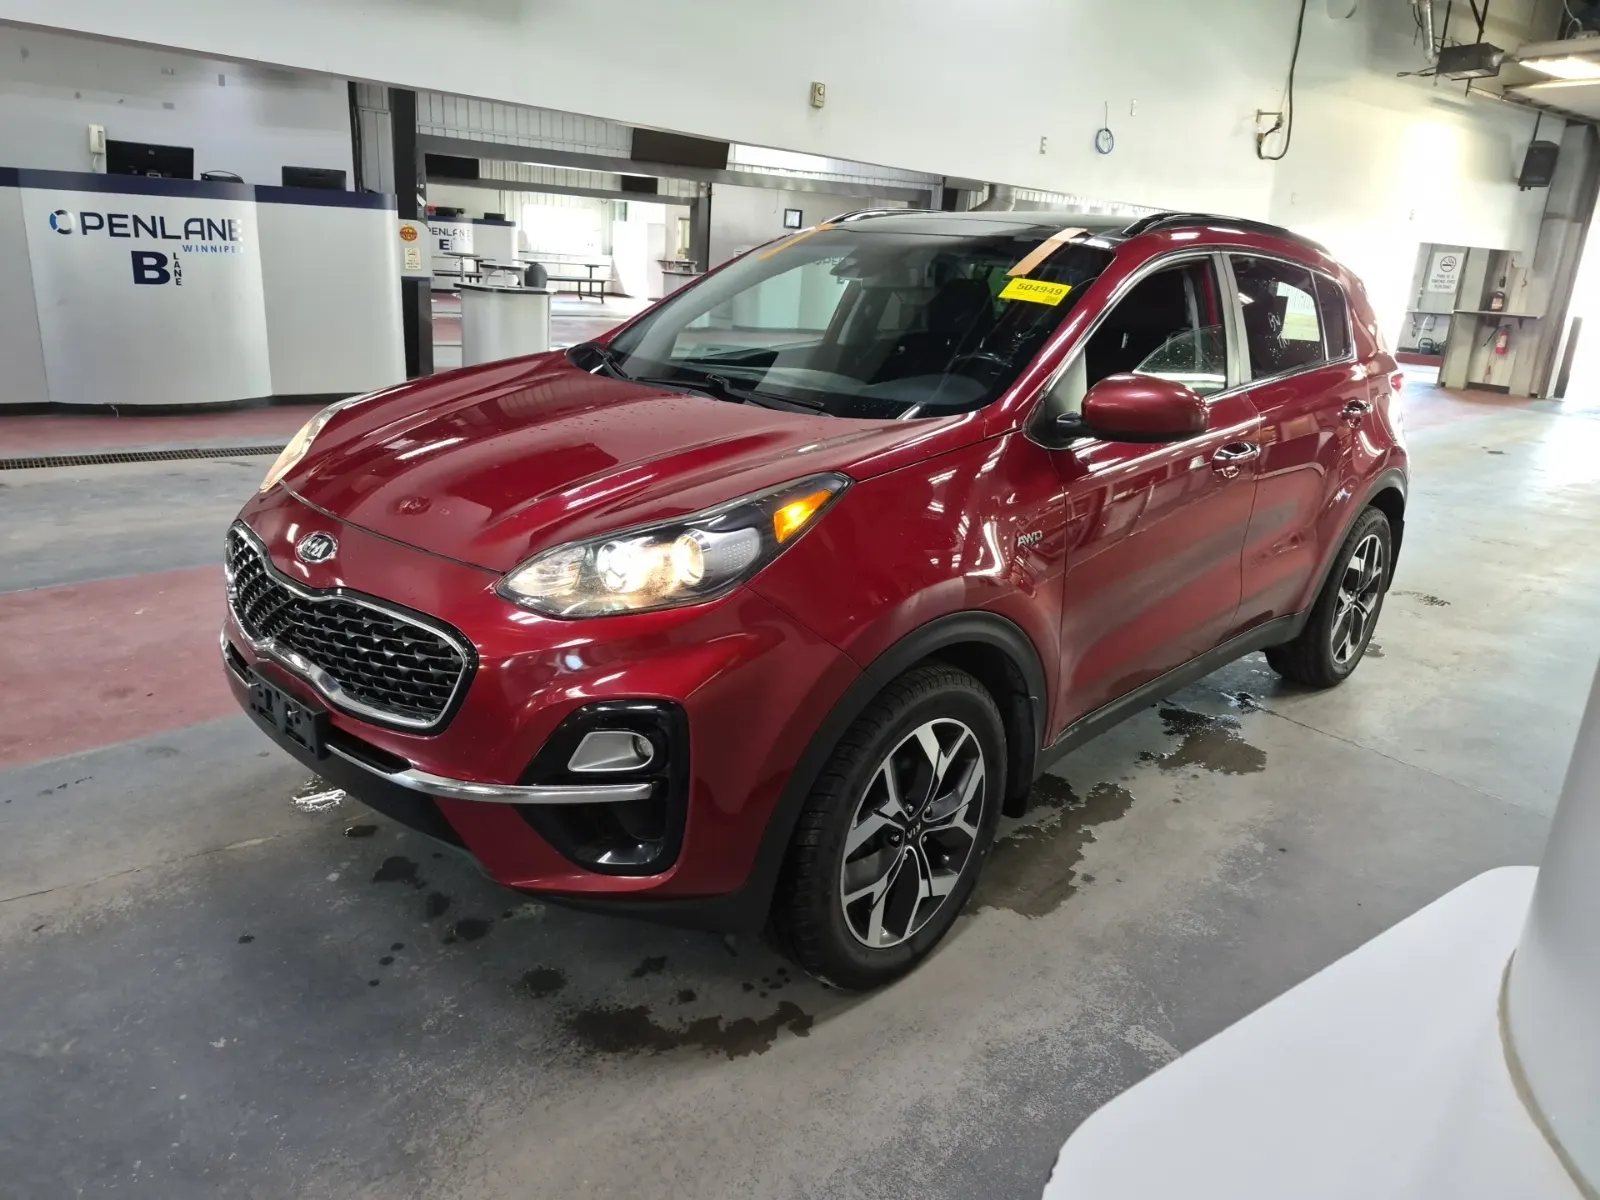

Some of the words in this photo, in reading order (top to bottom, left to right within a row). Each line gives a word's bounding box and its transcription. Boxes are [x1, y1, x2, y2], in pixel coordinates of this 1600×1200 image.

[49, 209, 243, 242] OPENLANE
[131, 250, 171, 285] B
[173, 252, 182, 286] LANE
[1017, 283, 1063, 295] 504949
[1017, 530, 1043, 547] AWD
